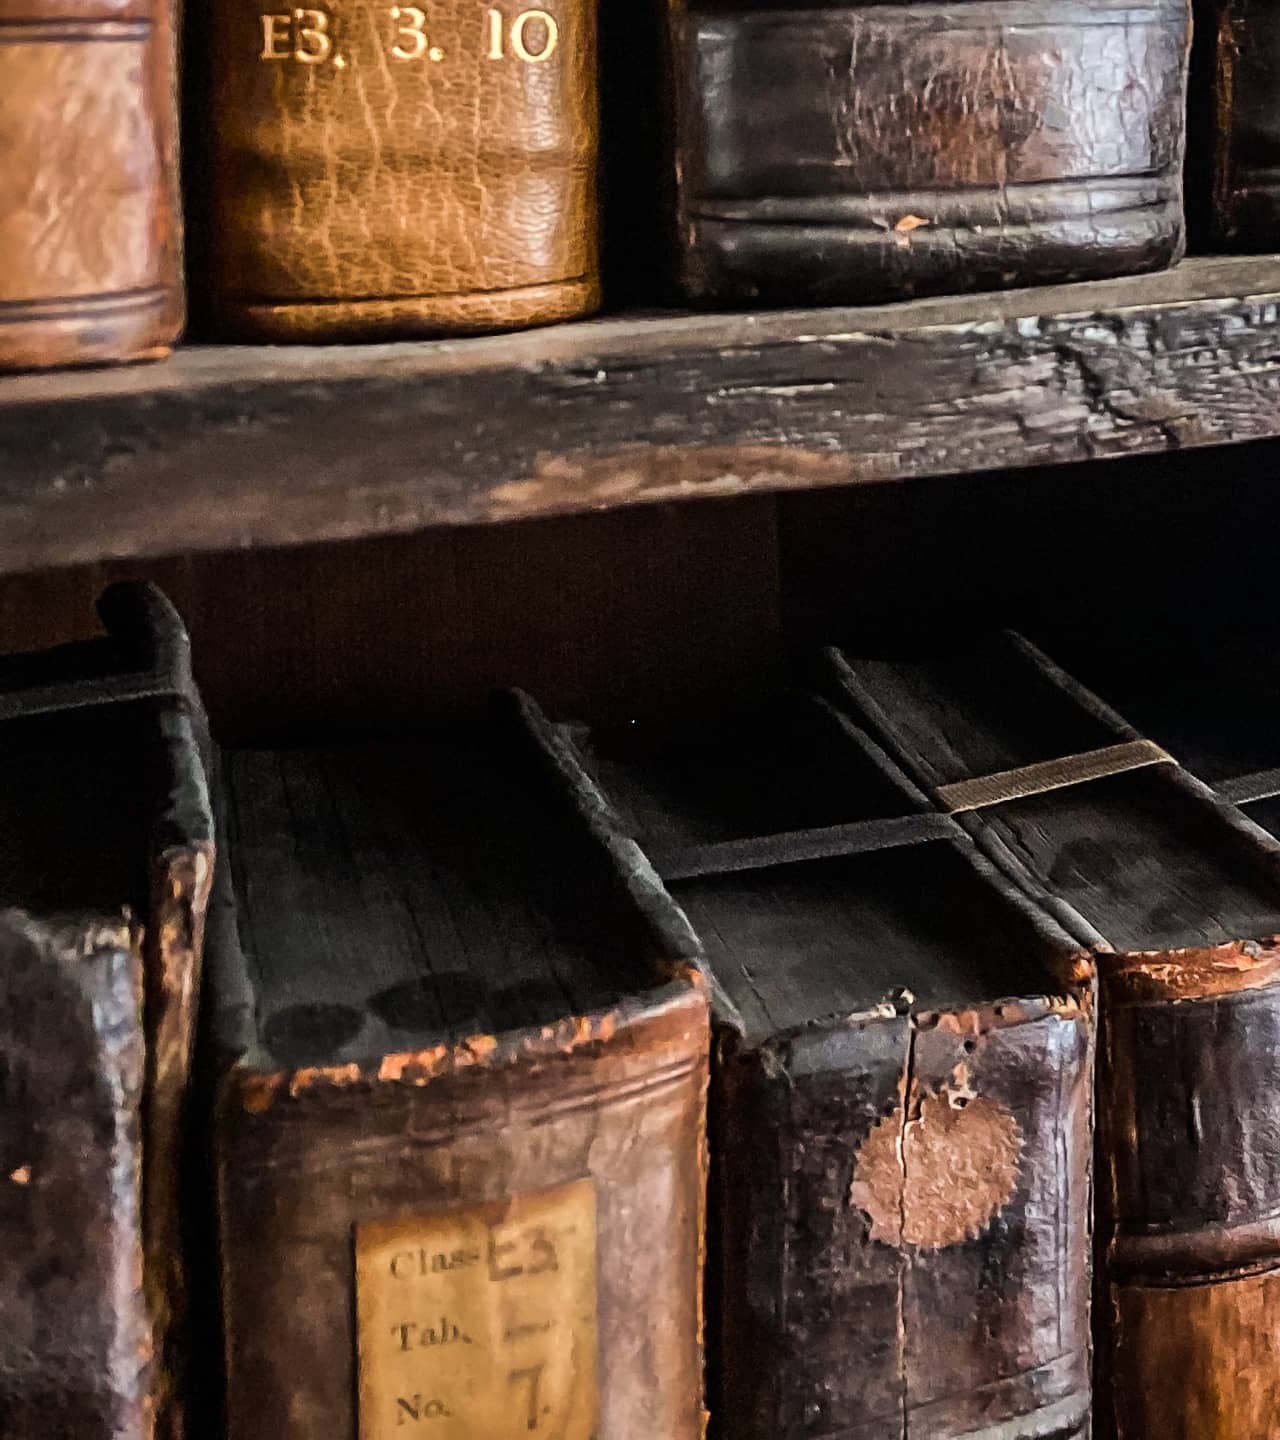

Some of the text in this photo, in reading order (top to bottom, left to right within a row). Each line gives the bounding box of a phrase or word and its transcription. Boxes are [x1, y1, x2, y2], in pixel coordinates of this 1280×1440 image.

[260, 9, 346, 69] E3.
[390, 6, 446, 62] 3.
[391, 1317, 472, 1352] Tab.
[397, 1394, 450, 1426] No.
